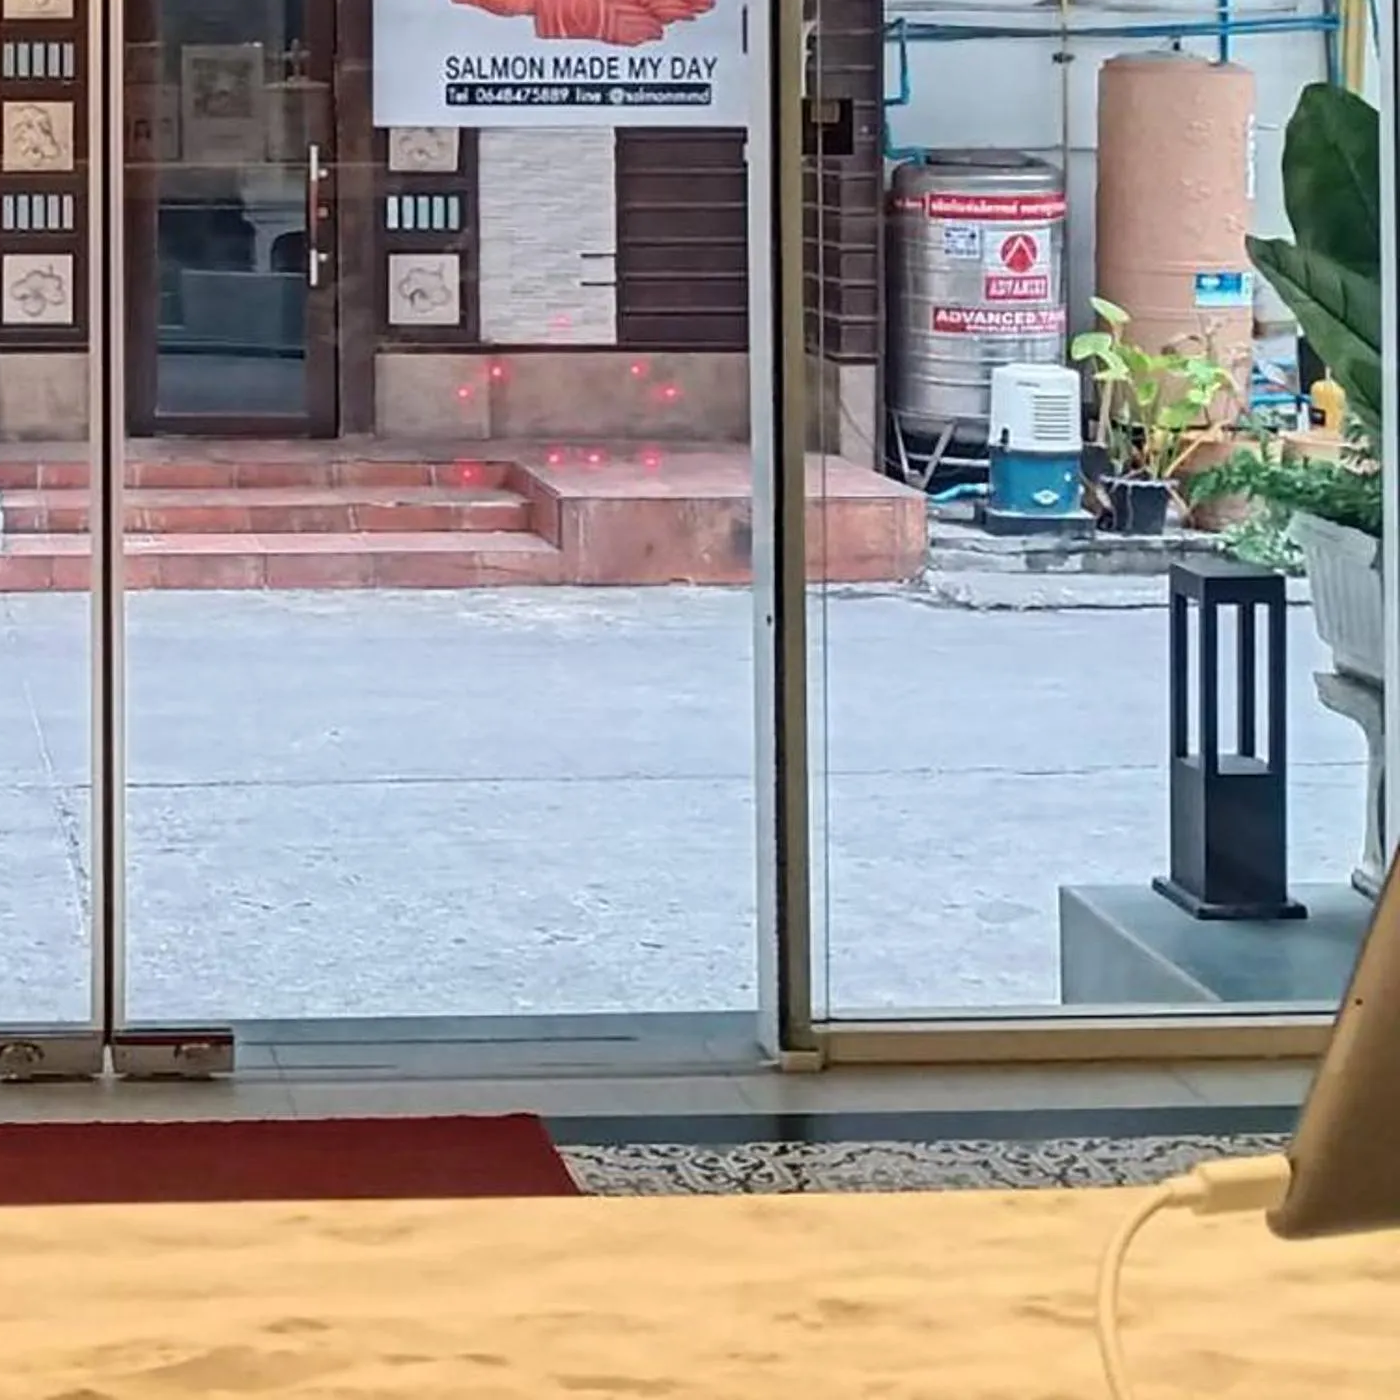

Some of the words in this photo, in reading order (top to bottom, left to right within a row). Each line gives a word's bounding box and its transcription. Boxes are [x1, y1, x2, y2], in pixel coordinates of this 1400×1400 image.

[445, 55, 545, 80] SALMON
[552, 55, 620, 80] MADE
[628, 55, 662, 80] MY
[670, 54, 718, 80] DAY
[935, 308, 1037, 325] ADVANCED
